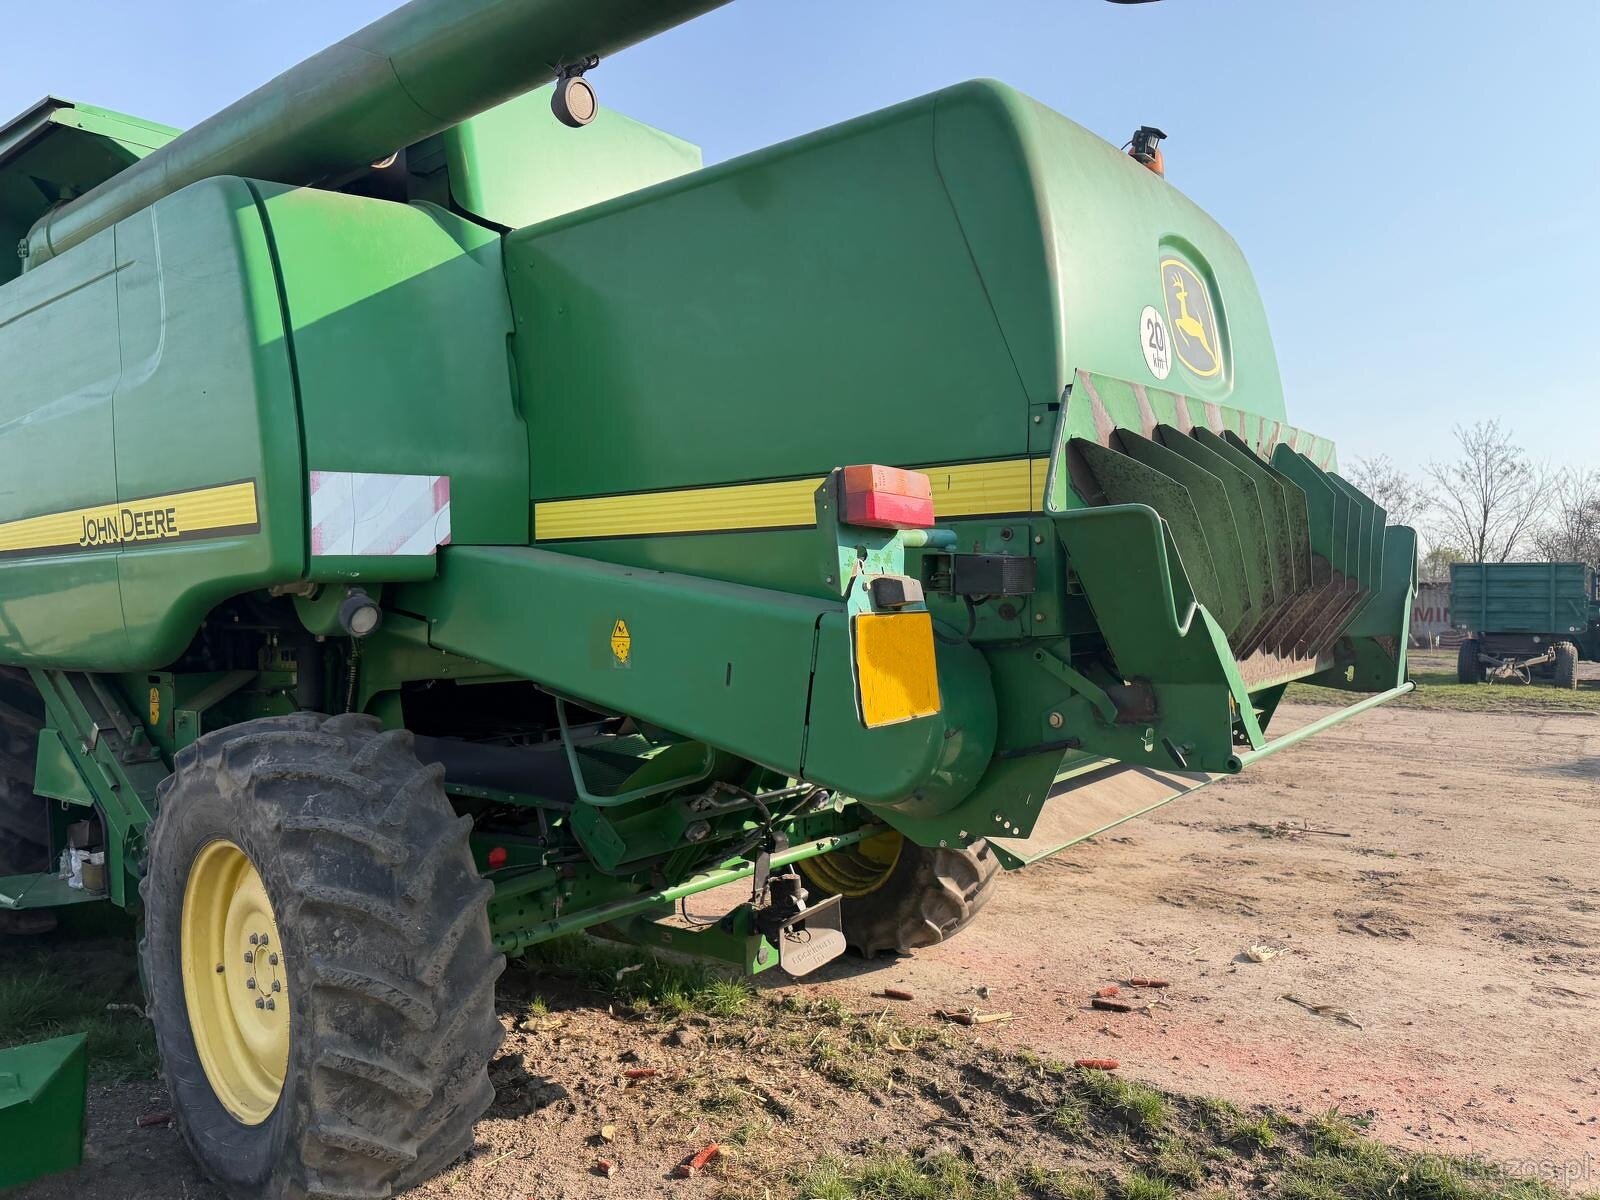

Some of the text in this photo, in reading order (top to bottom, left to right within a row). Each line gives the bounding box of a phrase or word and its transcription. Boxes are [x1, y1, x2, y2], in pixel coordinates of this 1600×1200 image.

[1147, 318, 1164, 352] 20
[79, 508, 178, 543] JOHN DEERE
